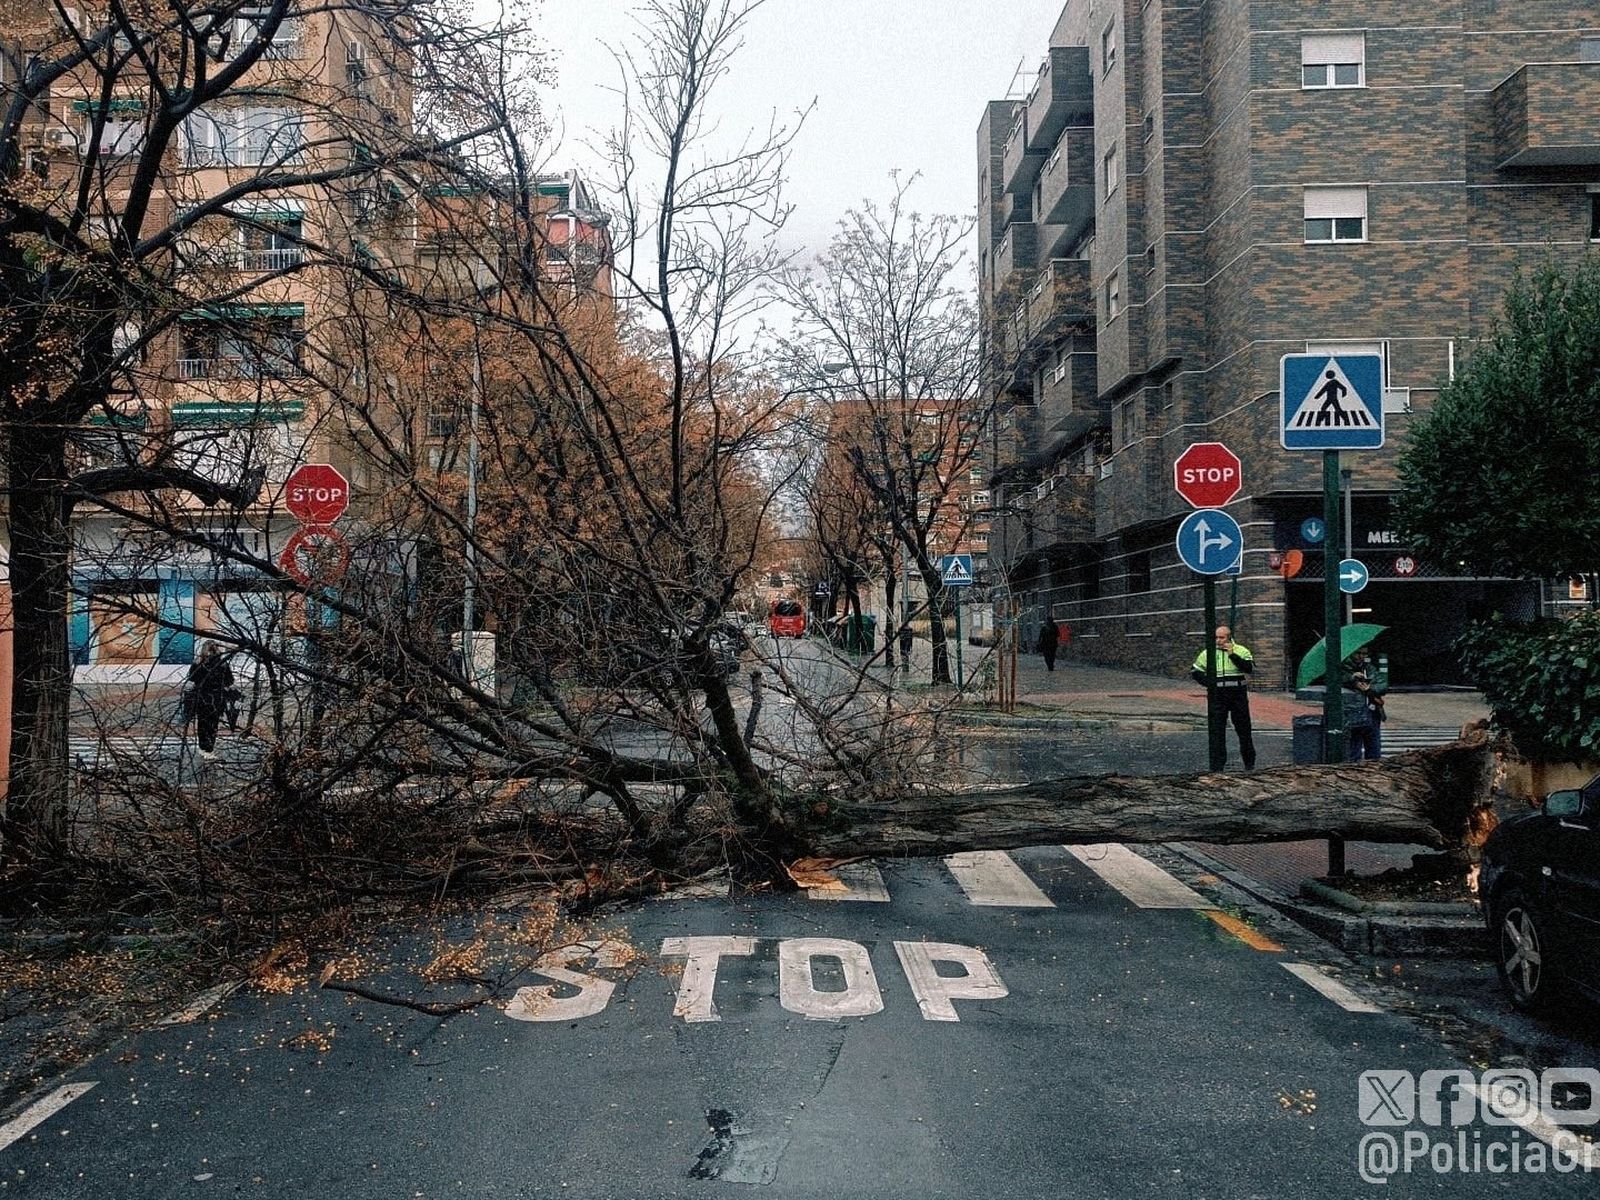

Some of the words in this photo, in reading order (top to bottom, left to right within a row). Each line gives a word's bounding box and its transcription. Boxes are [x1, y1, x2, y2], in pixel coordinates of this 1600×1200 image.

[1183, 467, 1234, 483] STOP
[292, 488, 342, 502] STOP
[503, 935, 1010, 1023] STOP
